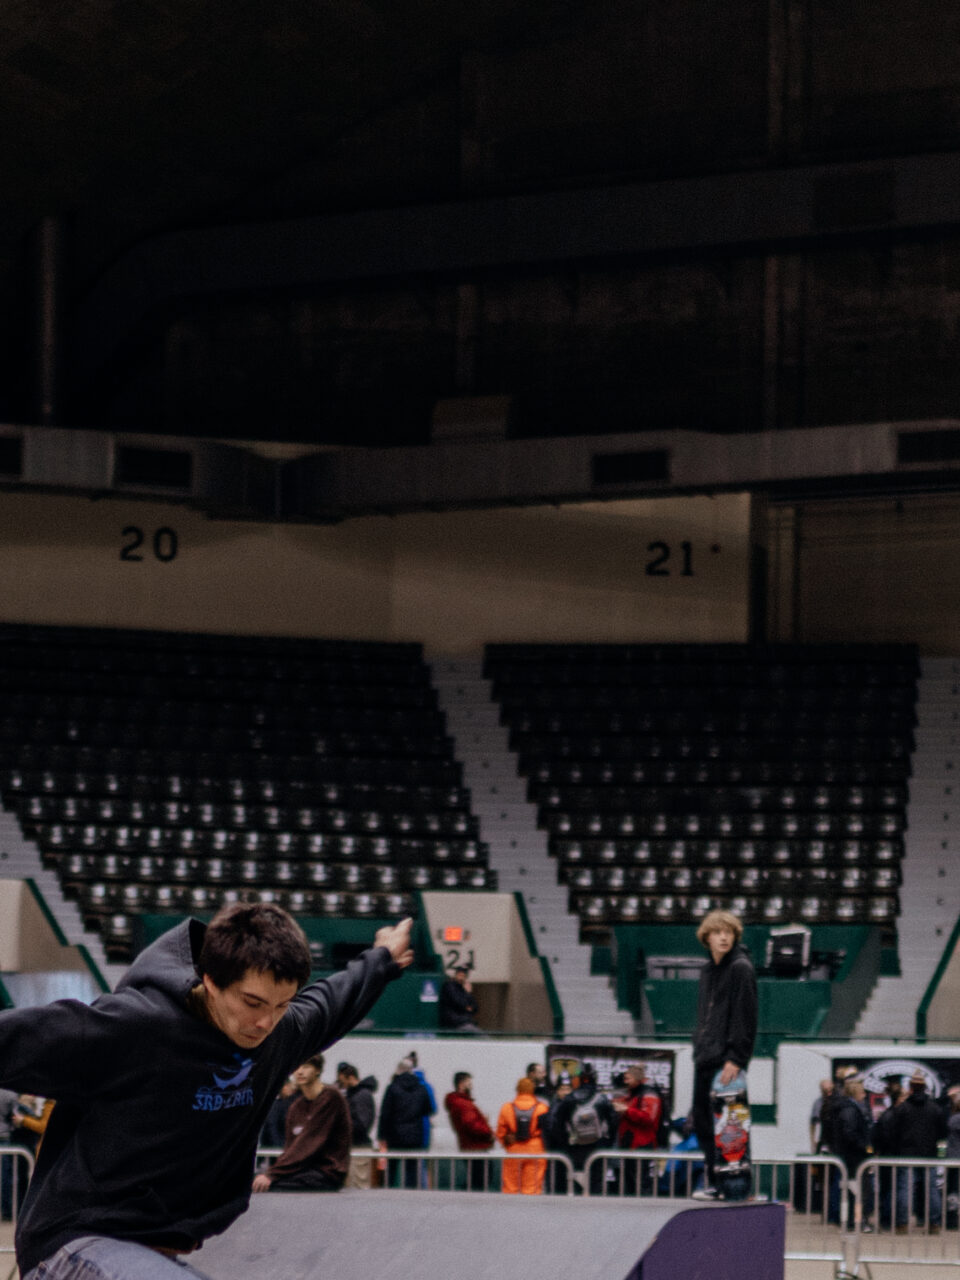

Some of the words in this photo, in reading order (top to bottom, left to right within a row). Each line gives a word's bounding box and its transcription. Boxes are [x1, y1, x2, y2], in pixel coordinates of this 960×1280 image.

[121, 526, 178, 562] 20
[645, 541, 694, 576] 21
[446, 949, 474, 970] 21
